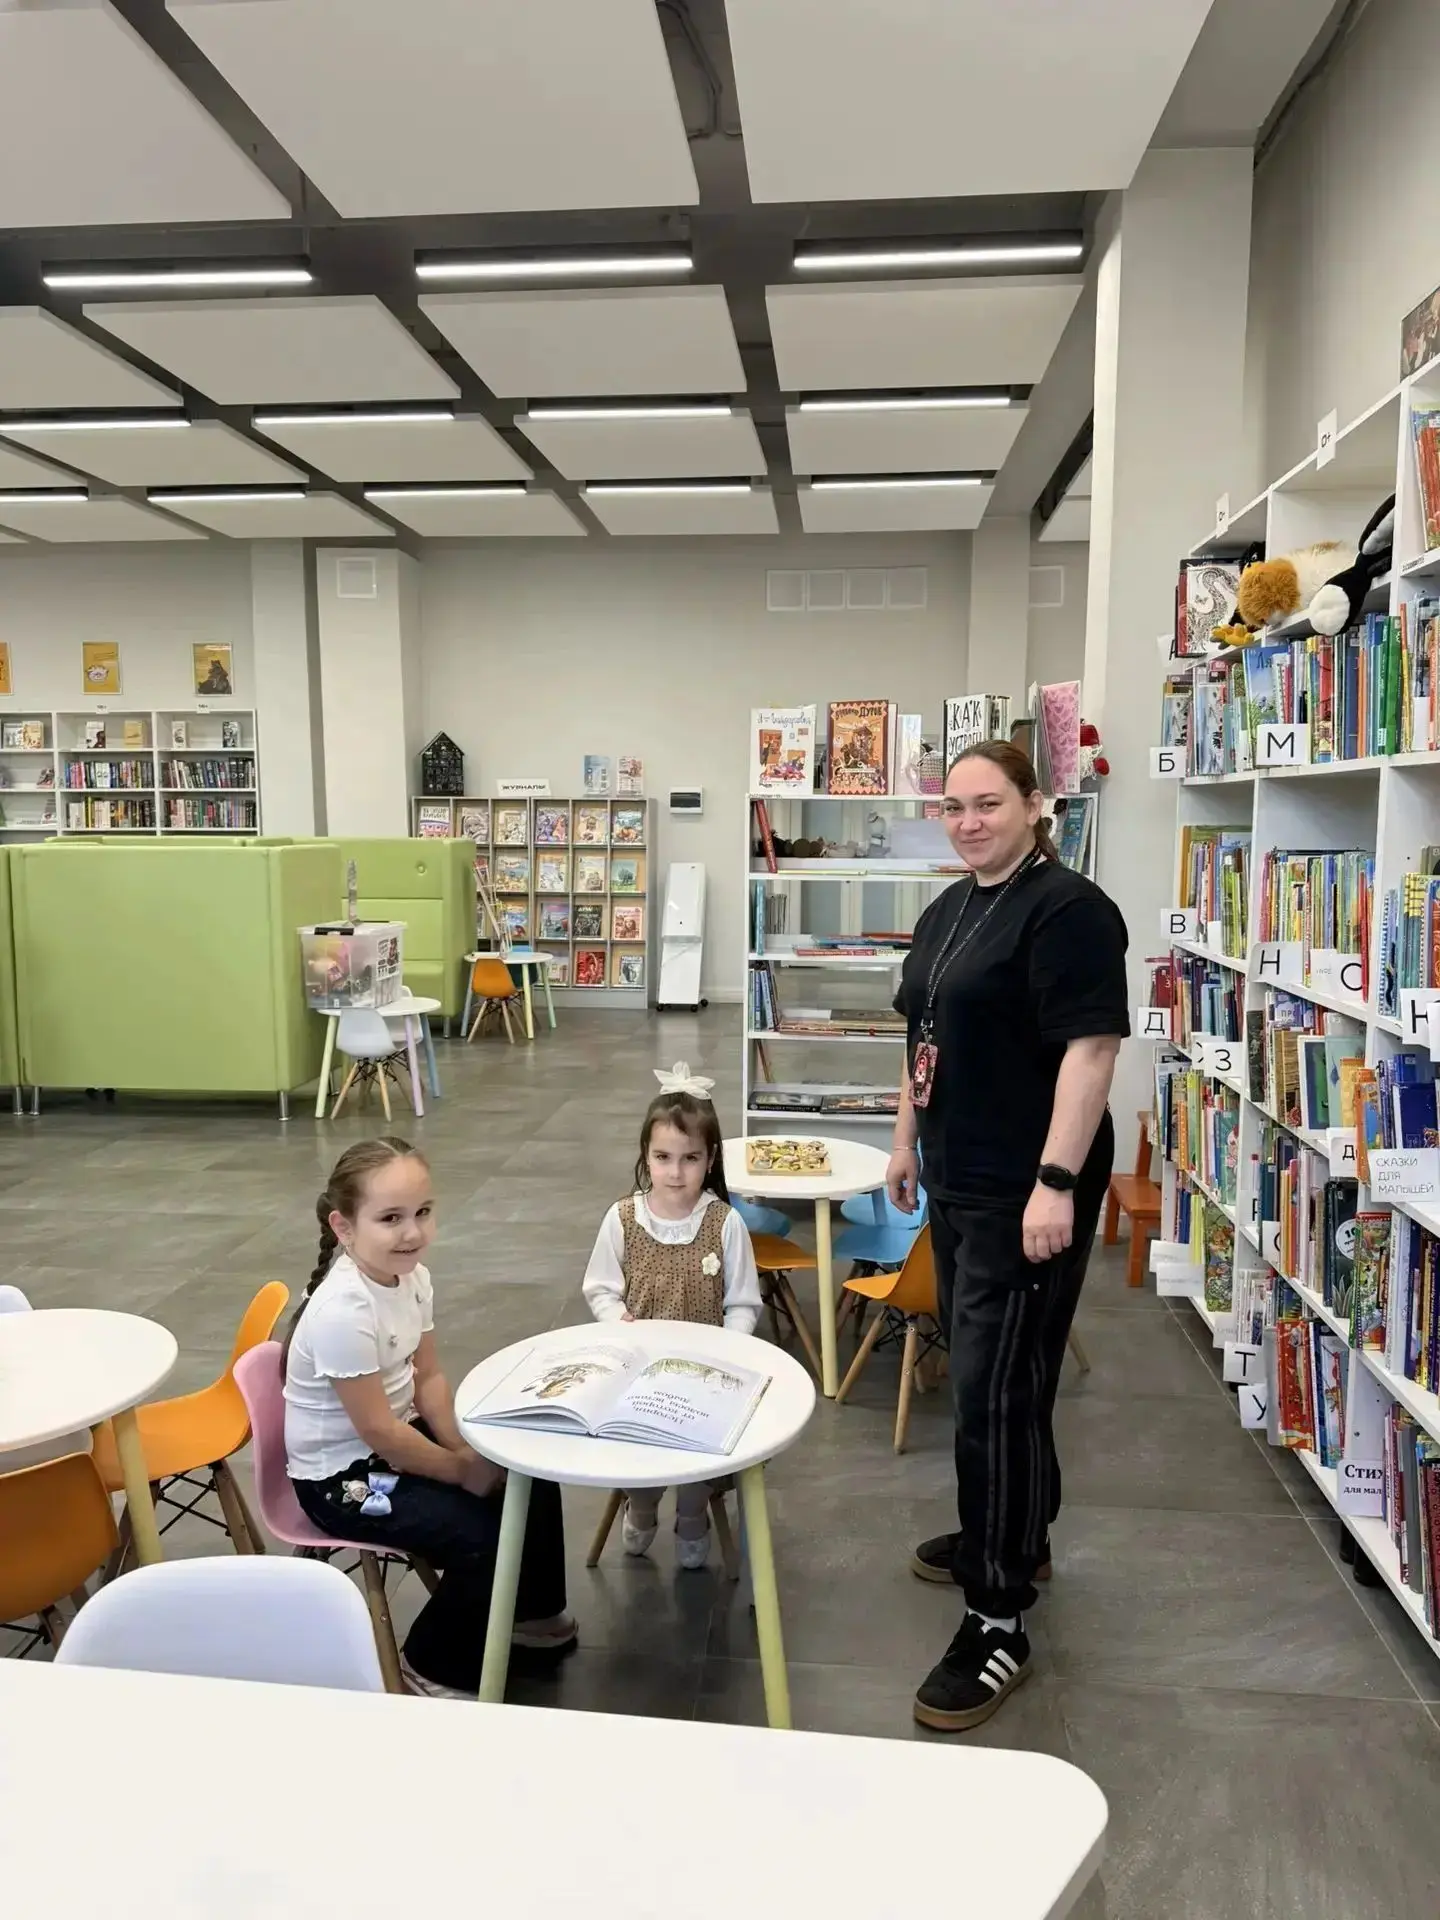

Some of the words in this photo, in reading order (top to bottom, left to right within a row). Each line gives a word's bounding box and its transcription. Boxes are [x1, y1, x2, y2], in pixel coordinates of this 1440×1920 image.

[1266, 731, 1295, 759] М
[1159, 752, 1175, 773] Б
[1170, 913, 1186, 934] В
[1259, 949, 1280, 975] Н
[1341, 962, 1363, 991] С
[1144, 1011, 1165, 1035] Д
[1375, 1157, 1418, 1167] СКАЗКИ
[1378, 1171, 1401, 1182] ДЛЯ
[1234, 1350, 1256, 1377] Т
[1343, 1486, 1362, 1494] для
